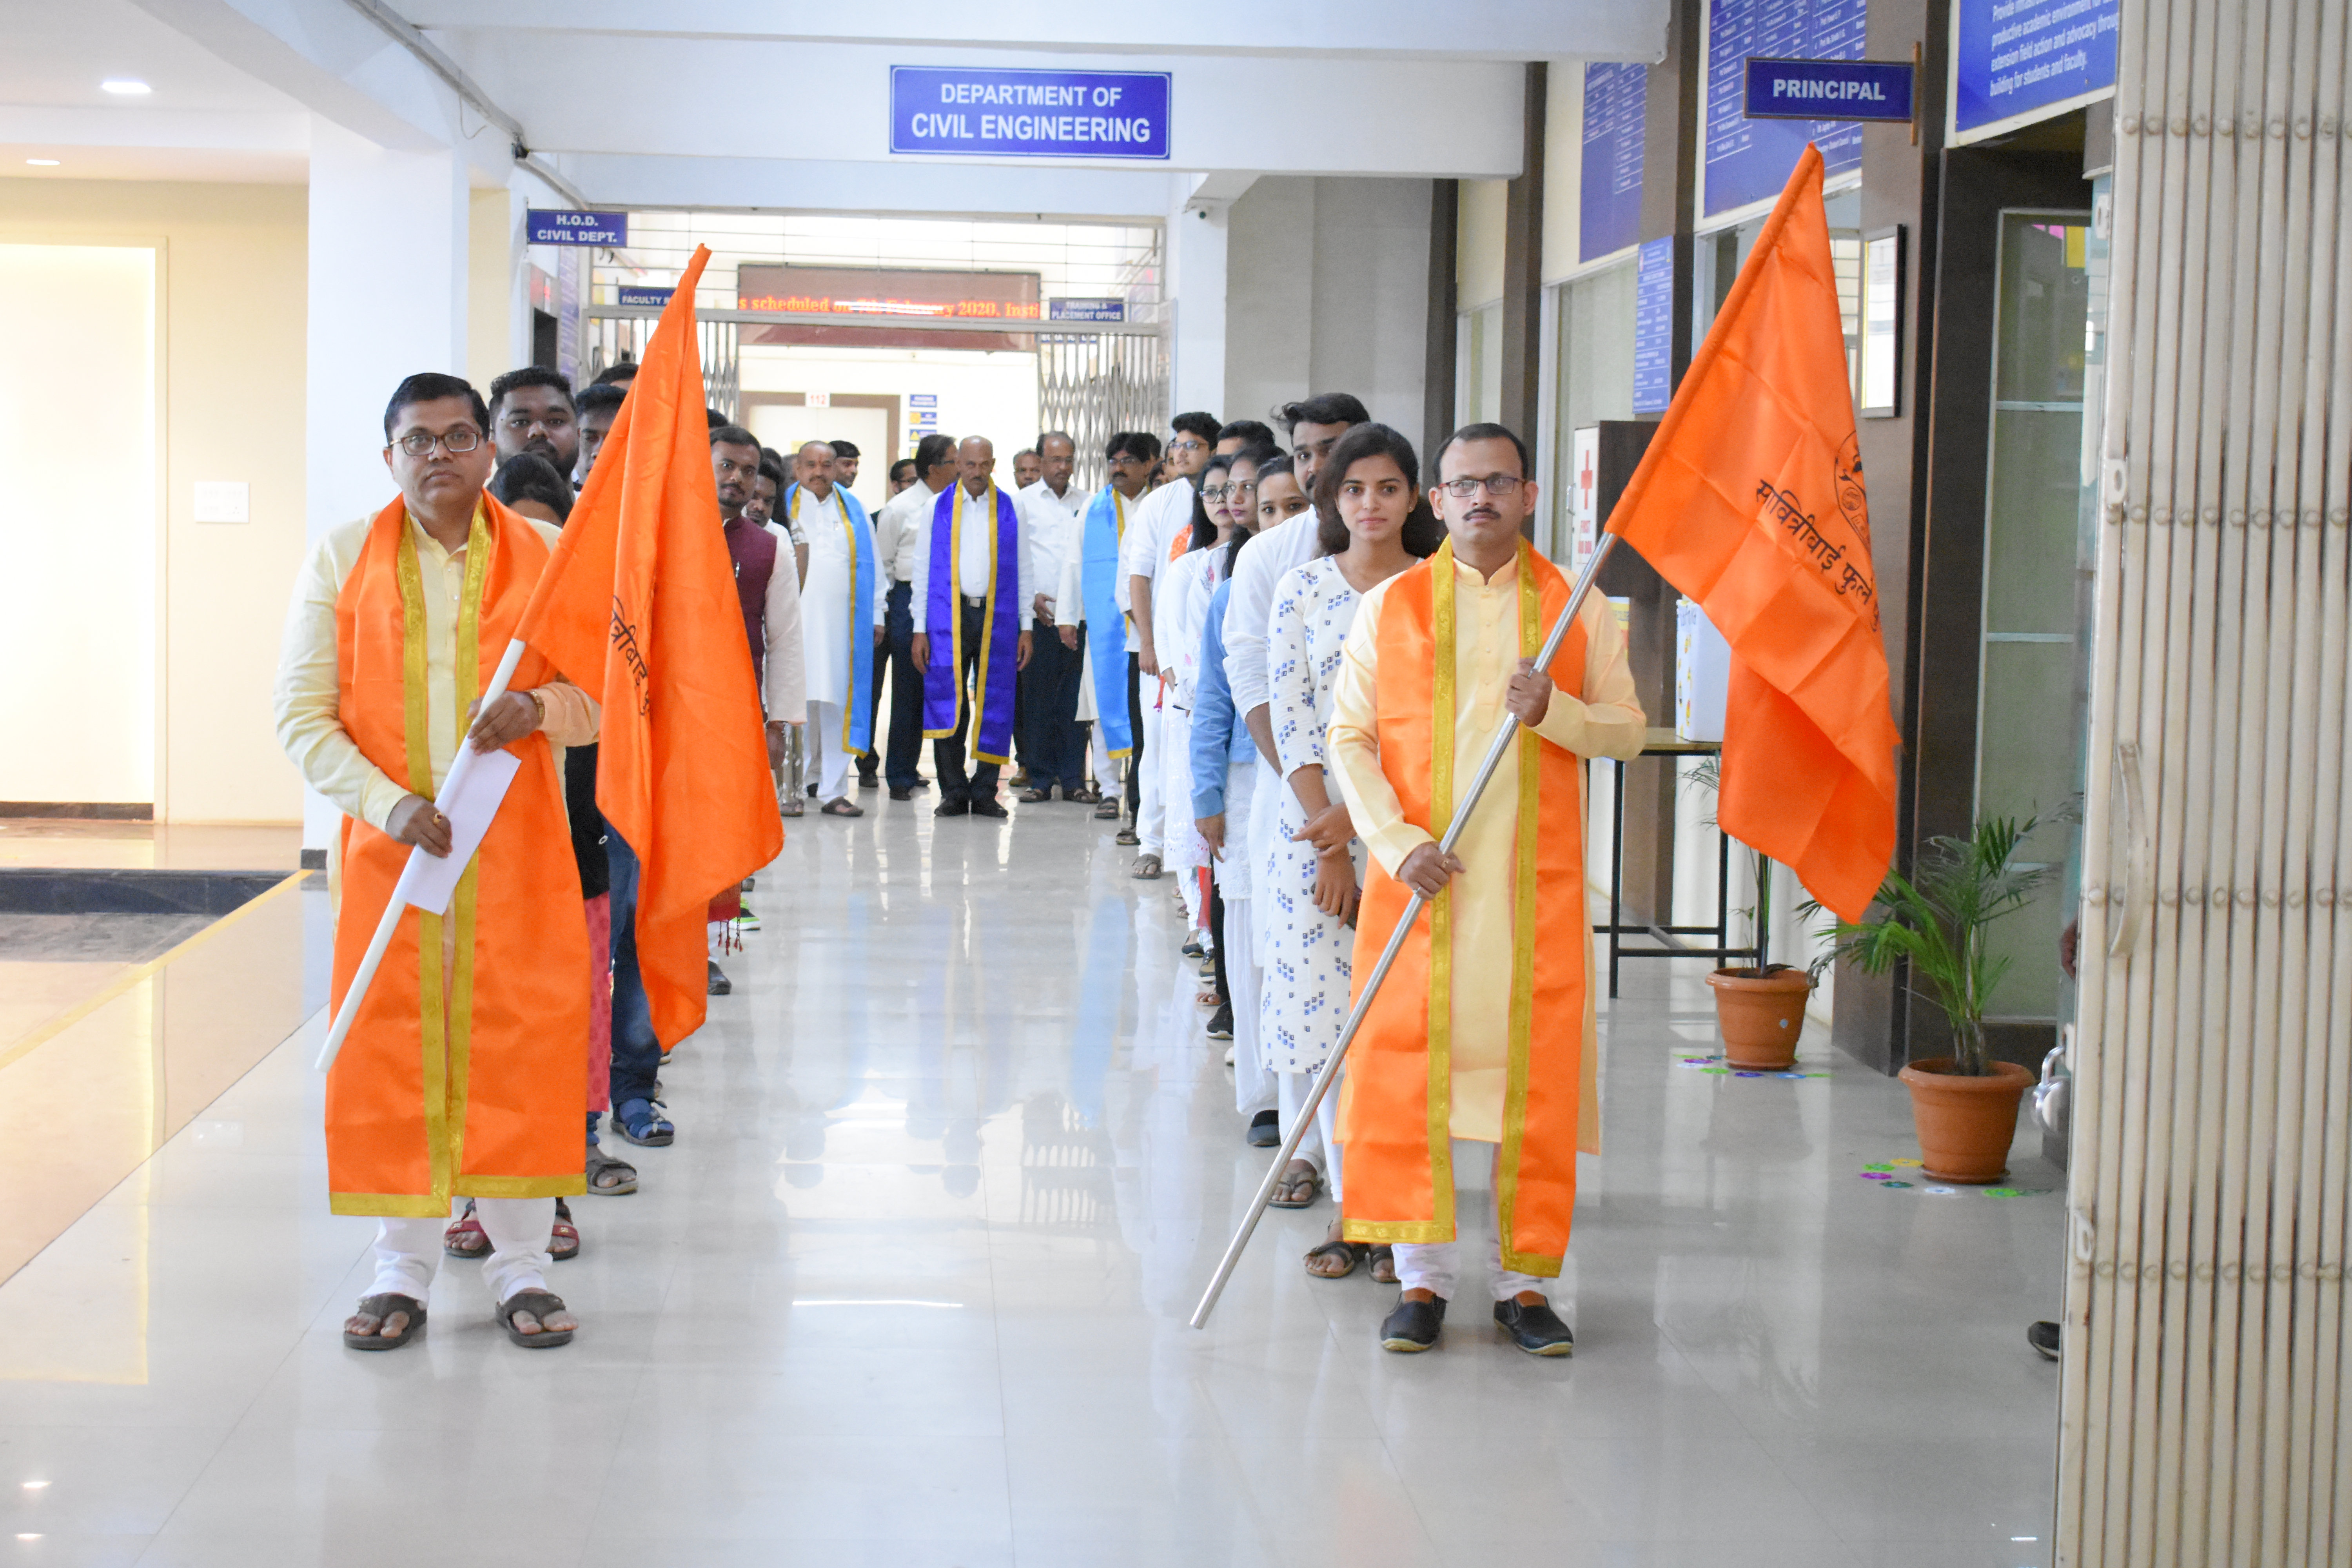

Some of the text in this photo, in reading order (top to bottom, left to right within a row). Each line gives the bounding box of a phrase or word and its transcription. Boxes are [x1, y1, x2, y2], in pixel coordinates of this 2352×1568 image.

[2023, 9, 2051, 35] academic
[2053, 28, 2065, 49] and
[2024, 62, 2050, 85] students
[2051, 54, 2063, 76] and
[941, 83, 1122, 107] DEPARTMENT OF
[1772, 78, 1886, 101] PRINCIPAL
[911, 113, 1151, 143] CIVIL ENGINEERING
[556, 214, 599, 226] H.O.D.
[537, 229, 617, 243] CIVIL DEPT.
[622, 295, 662, 305] FACULTY
[751, 295, 830, 312] scheduled
[885, 298, 956, 318] Fbary
[958, 300, 1001, 317] 2020.
[1004, 301, 1039, 318] Insti
[1051, 311, 1122, 320] PLACEMENT OFFICE
[810, 395, 826, 405] 112
